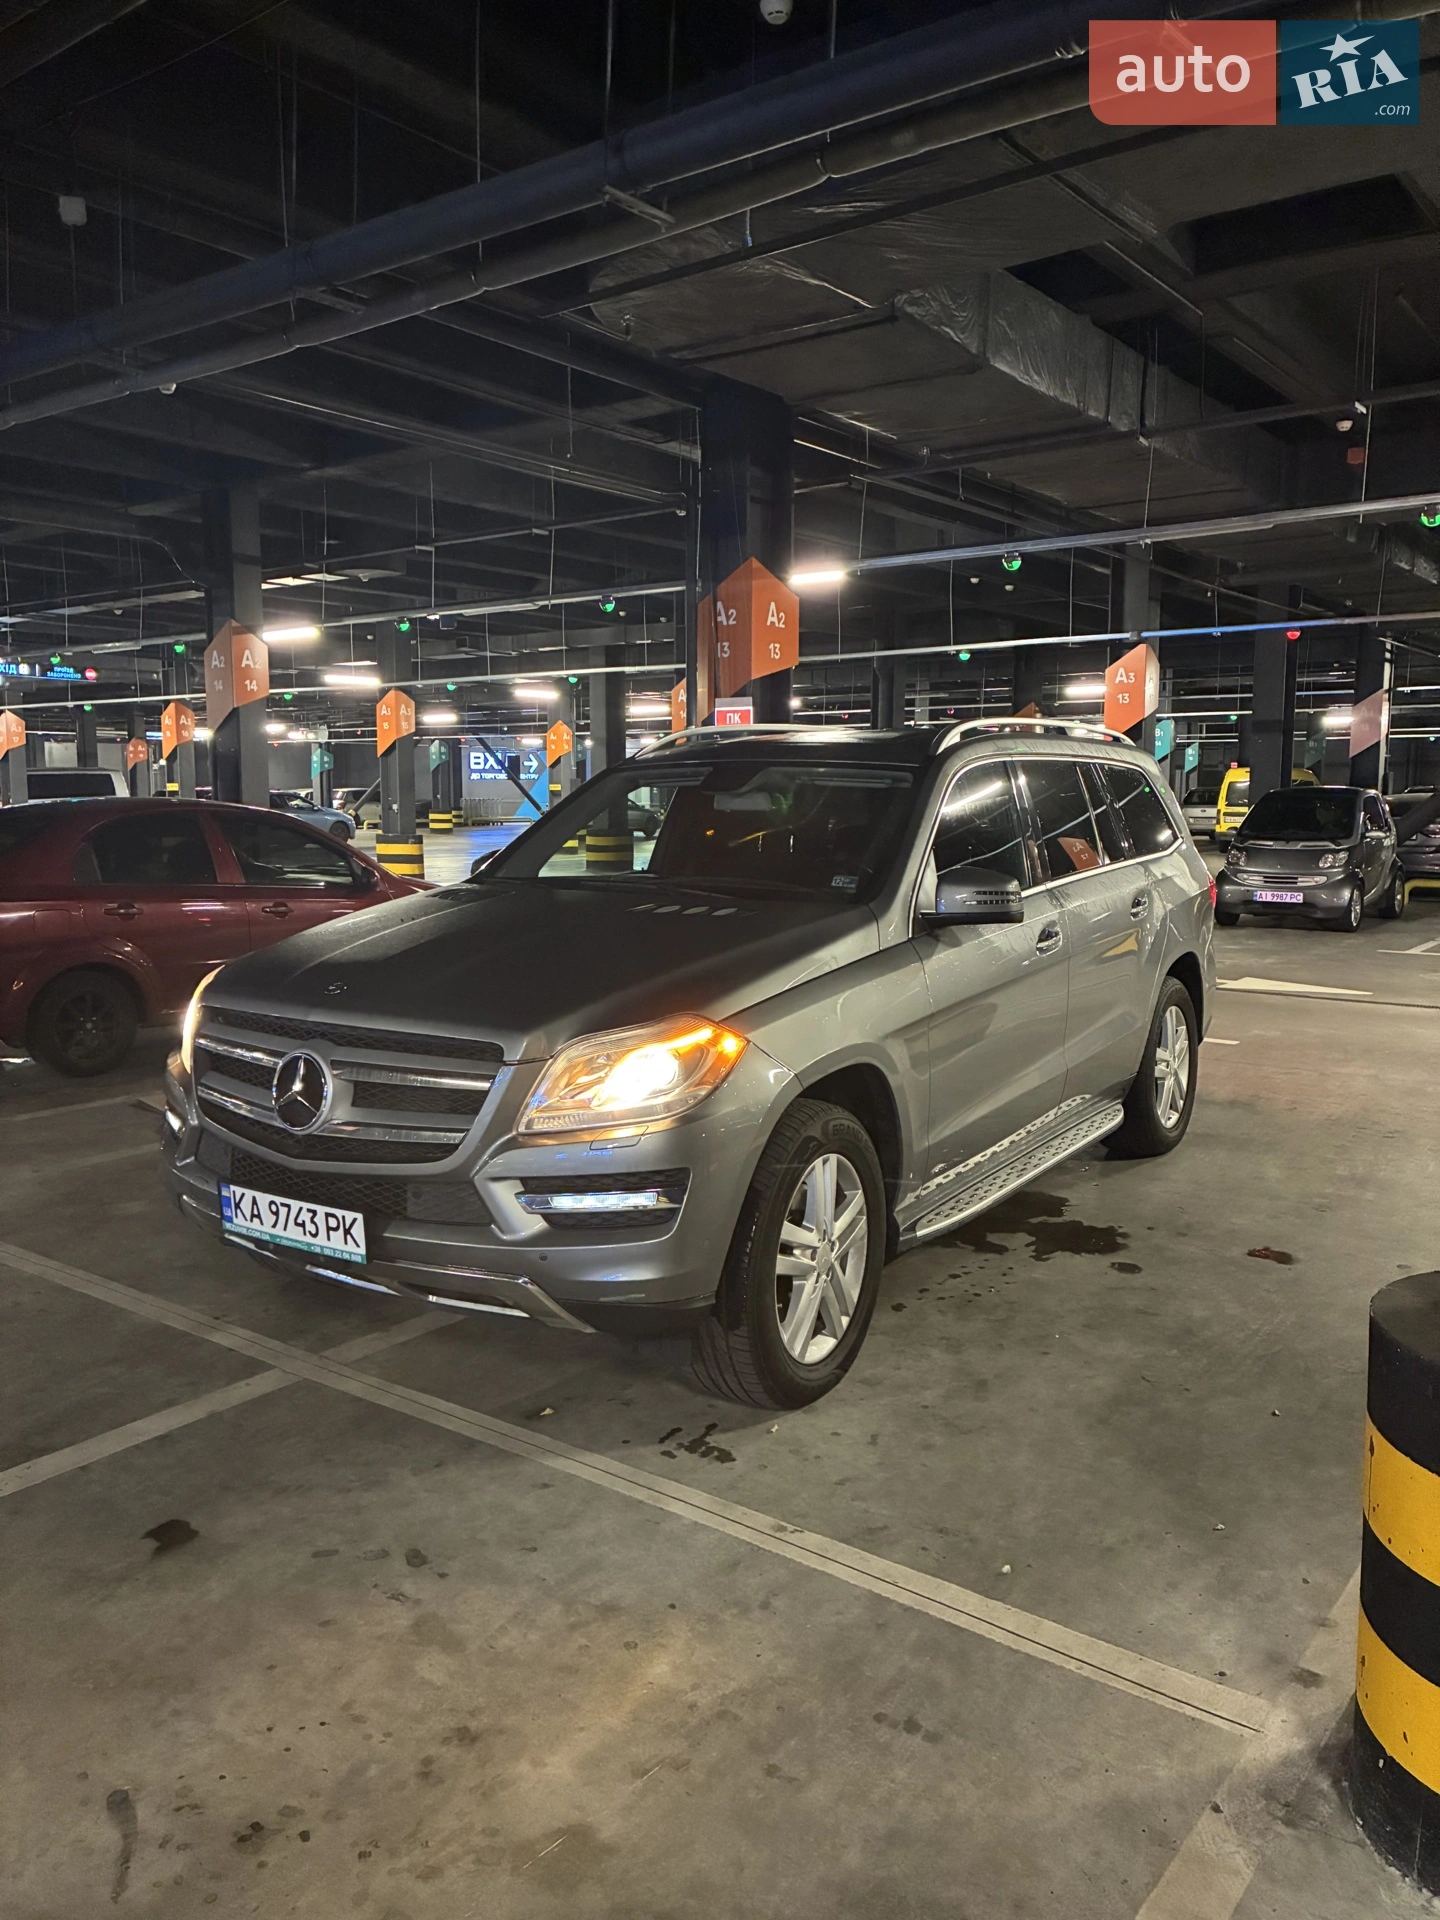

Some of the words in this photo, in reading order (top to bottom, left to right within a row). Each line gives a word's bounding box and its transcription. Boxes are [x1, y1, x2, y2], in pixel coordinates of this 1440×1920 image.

[717, 601, 737, 626] A2
[767, 601, 785, 628] A2
[718, 642, 730, 658] 13
[769, 643, 781, 659] 13
[211, 650, 226, 669] A2
[241, 649, 261, 669] A2
[1115, 667, 1136, 685] A3
[213, 679, 223, 692] 14
[244, 679, 258, 692] 14
[677, 689, 686, 702] A
[1117, 692, 1130, 704] 13
[381, 703, 392, 716] A3
[400, 703, 412, 716] A3
[180, 714, 192, 725] A3
[726, 712, 742, 725] ПК
[1155, 728, 1164, 737] B1
[1258, 892, 1268, 900] AI
[1271, 892, 1288, 901] 9987
[1289, 893, 1302, 902] PC
[232, 1190, 264, 1226] KA
[268, 1200, 320, 1240] 9743
[324, 1211, 361, 1249] PK
